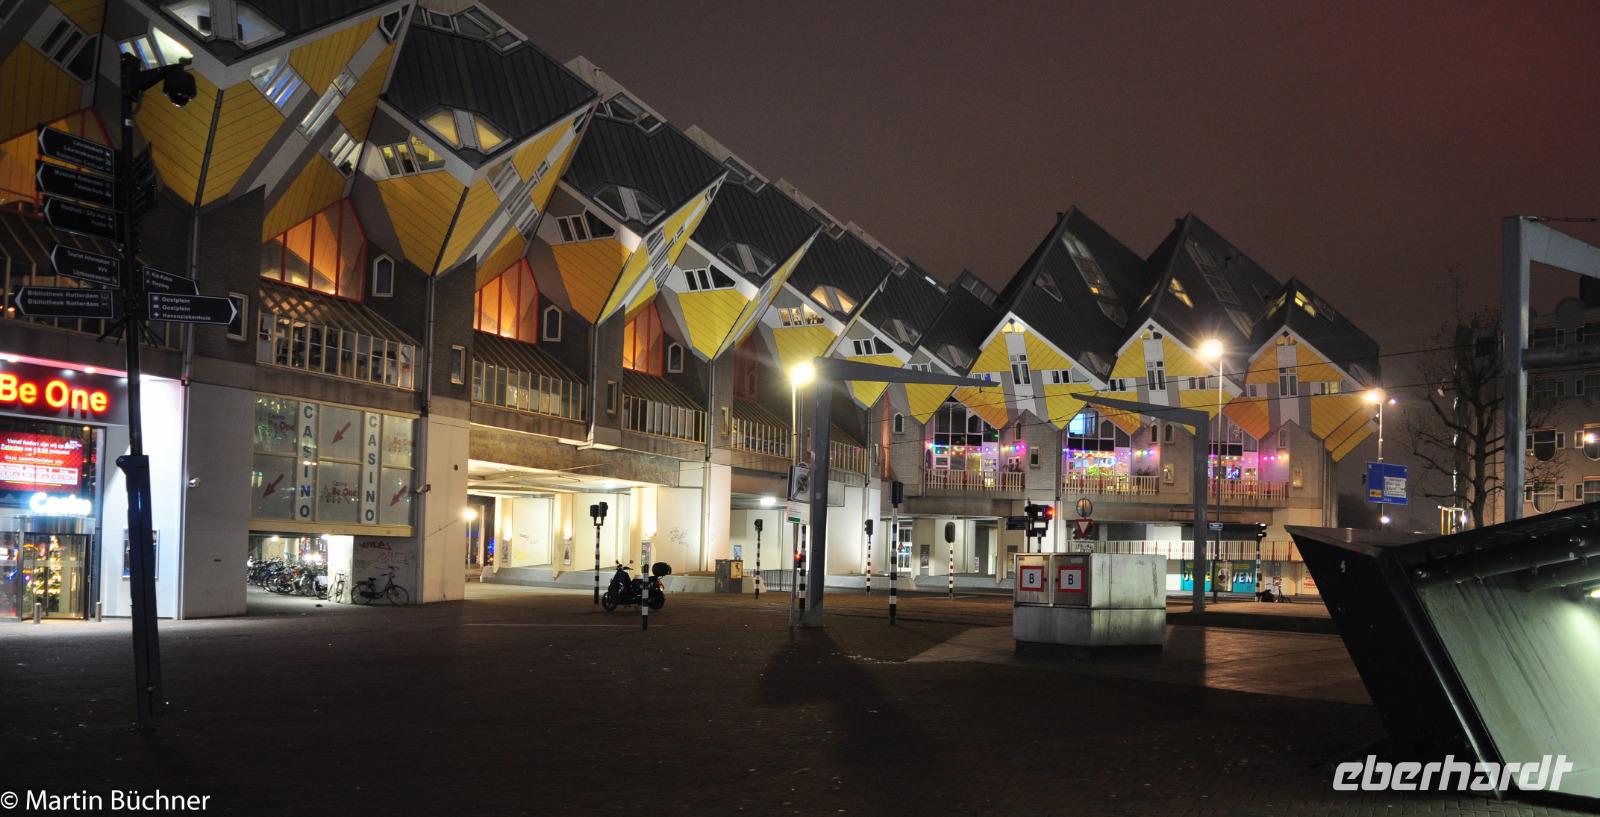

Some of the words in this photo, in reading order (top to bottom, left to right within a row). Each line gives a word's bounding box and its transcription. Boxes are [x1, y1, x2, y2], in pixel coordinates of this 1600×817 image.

[66, 291, 99, 299] Rotterdam
[161, 296, 190, 304] Oostplein
[161, 304, 191, 312] Oostplein
[0, 372, 38, 404] Be
[45, 380, 109, 412] One
[300, 405, 314, 518] CASINO
[365, 415, 378, 522] CASINO
[1029, 573, 1035, 584] B
[1068, 574, 1074, 585] B
